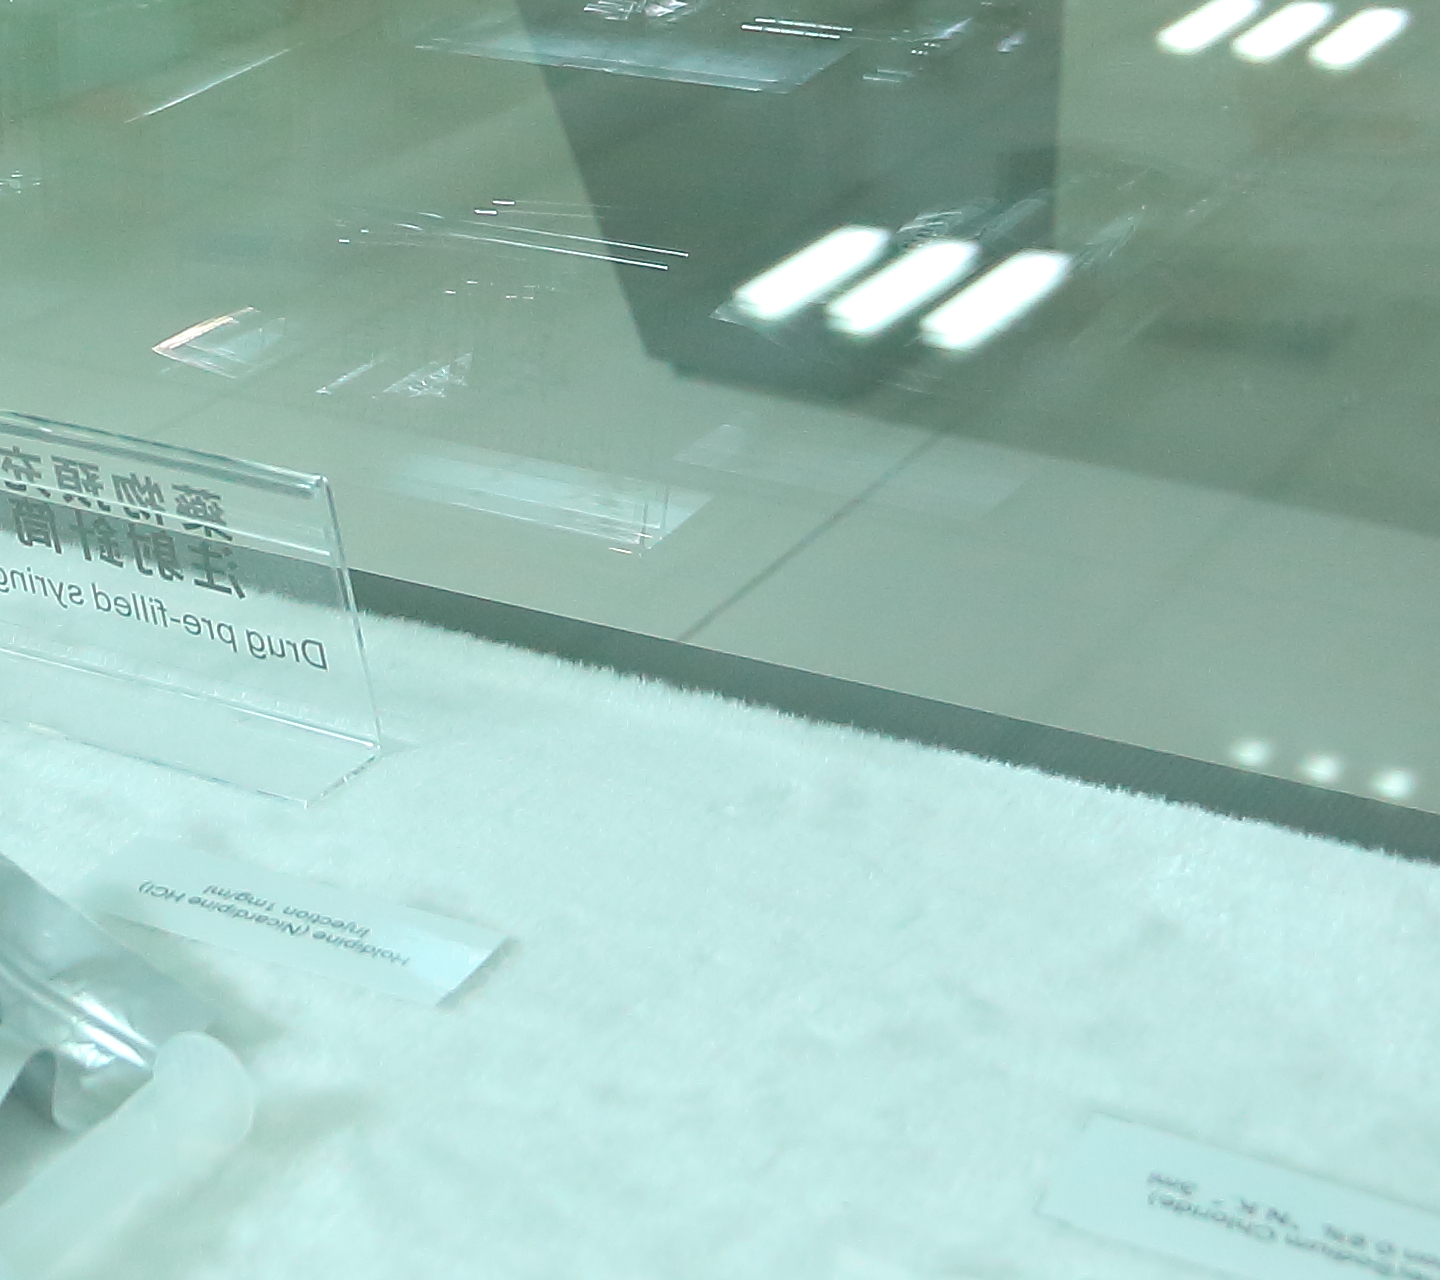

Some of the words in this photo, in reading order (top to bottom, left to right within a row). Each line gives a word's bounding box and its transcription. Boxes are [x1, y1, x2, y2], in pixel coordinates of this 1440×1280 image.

[138, 880, 187, 903] HCl)
[203, 884, 276, 911] 1mg/ml
[188, 895, 310, 936] (Nicardipine
[283, 904, 371, 938] Injection
[312, 928, 411, 966] Holdipine
